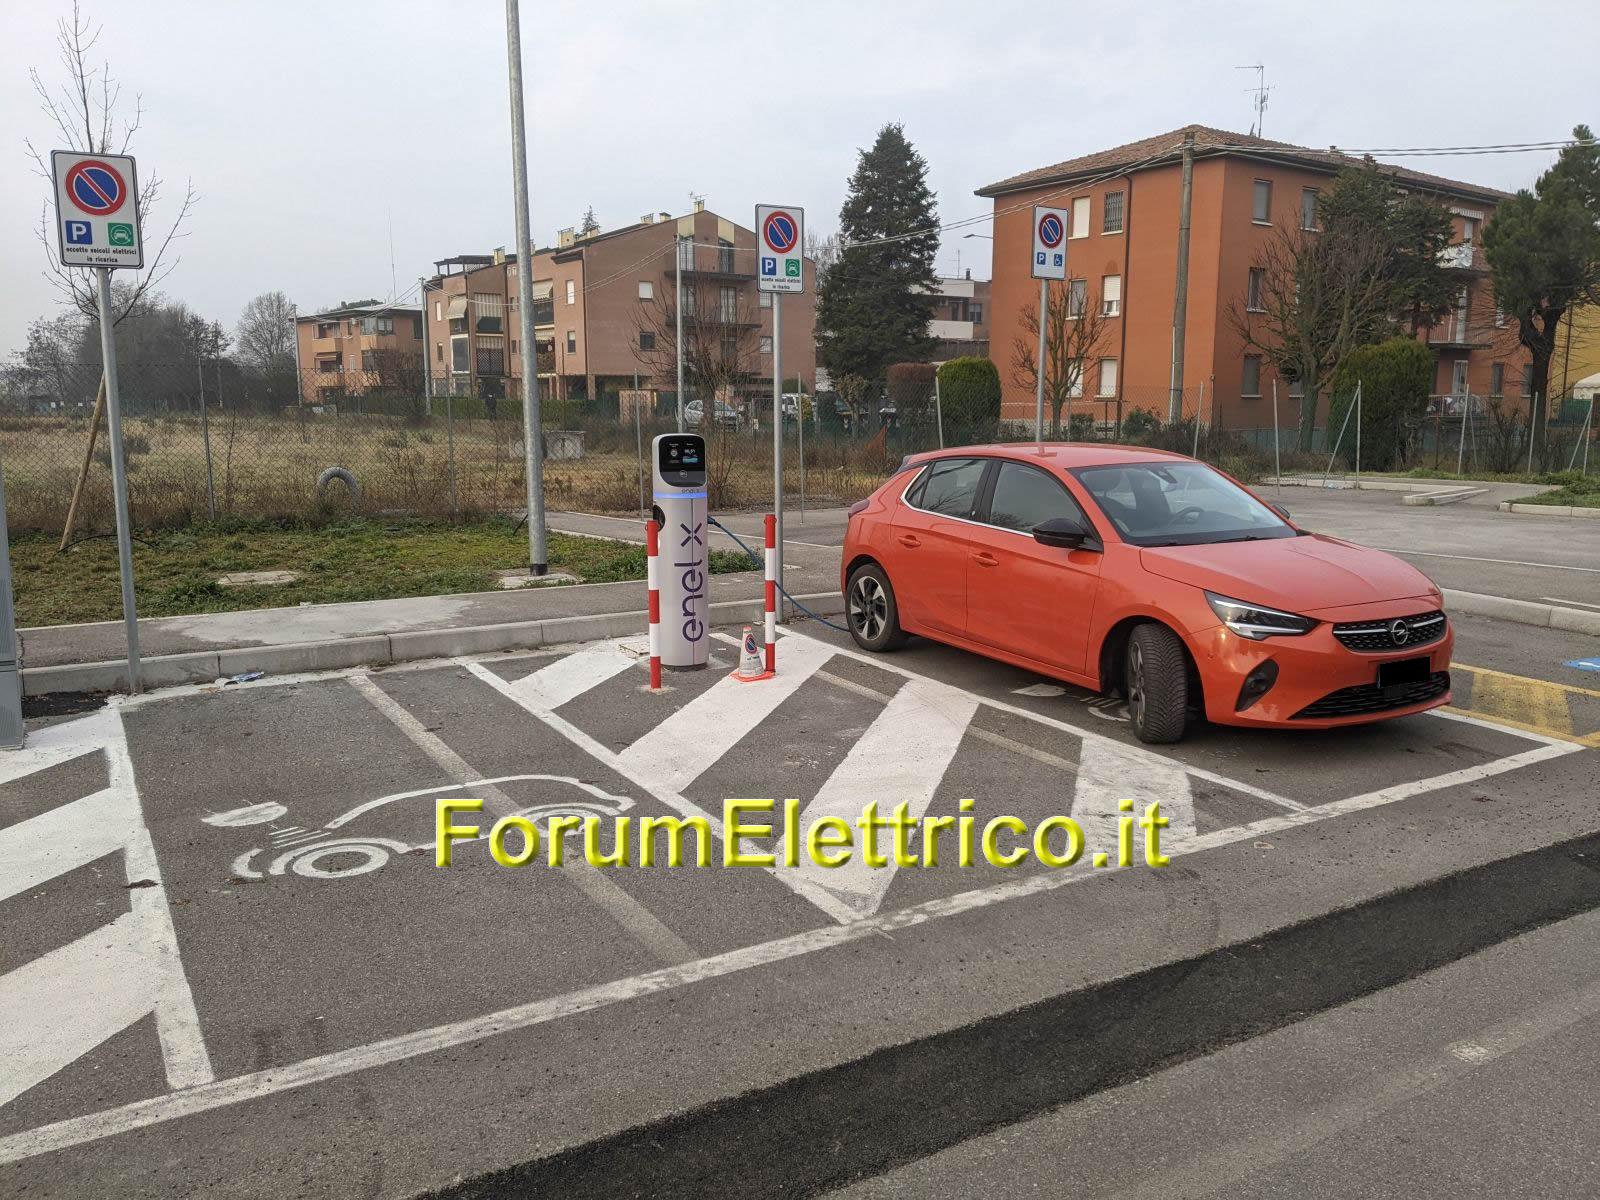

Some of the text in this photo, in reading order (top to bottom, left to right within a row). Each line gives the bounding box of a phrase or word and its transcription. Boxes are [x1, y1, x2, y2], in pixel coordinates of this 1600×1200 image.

[71, 223, 87, 241] P
[765, 259, 774, 273] P
[674, 559, 704, 642] enel
